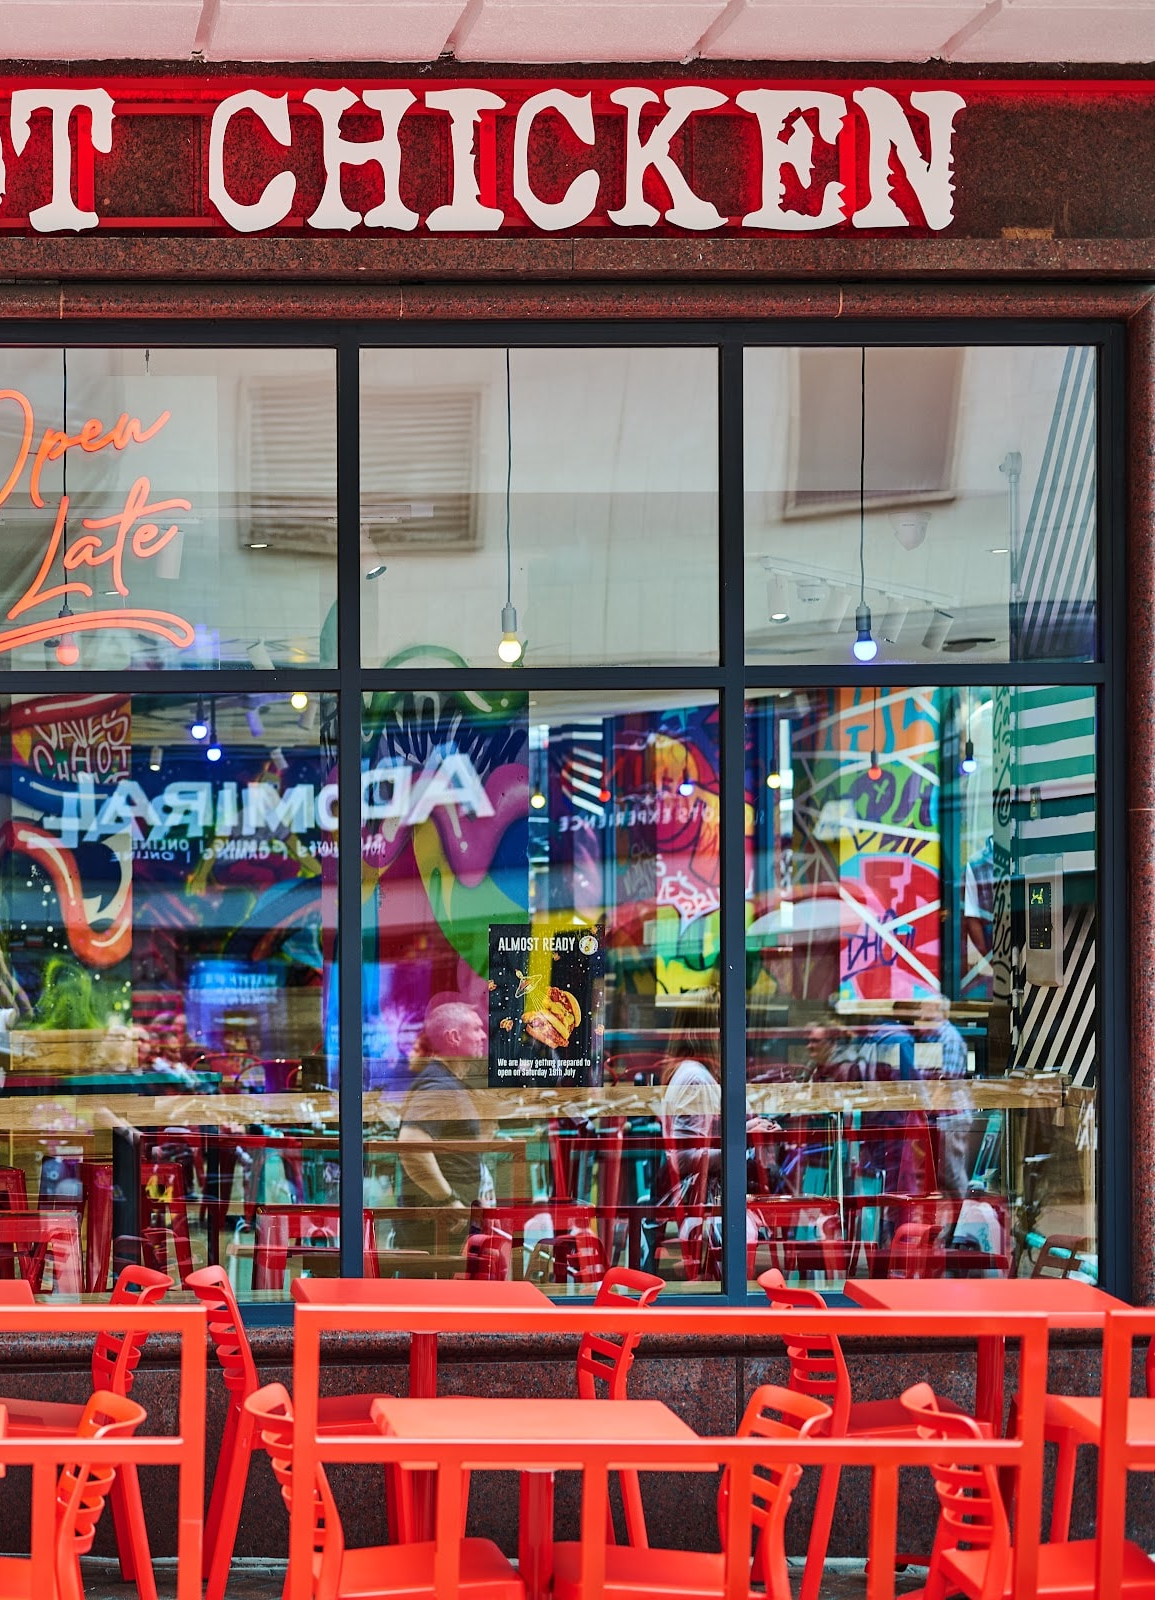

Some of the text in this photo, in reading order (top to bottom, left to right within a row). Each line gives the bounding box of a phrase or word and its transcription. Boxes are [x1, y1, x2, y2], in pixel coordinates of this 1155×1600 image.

[208, 85, 967, 233] CHICKEN
[6, 476, 192, 620] Late
[498, 937, 575, 951] ALMOST READY
[497, 1058, 507, 1067] We
[519, 1058, 533, 1069] busy
[534, 1058, 556, 1068] getting
[557, 1058, 583, 1068] prepared
[584, 1059, 591, 1067] to
[497, 1069, 512, 1078] open
[512, 1069, 520, 1077] on
[521, 1068, 547, 1078] Saturday
[563, 1068, 576, 1078] July
